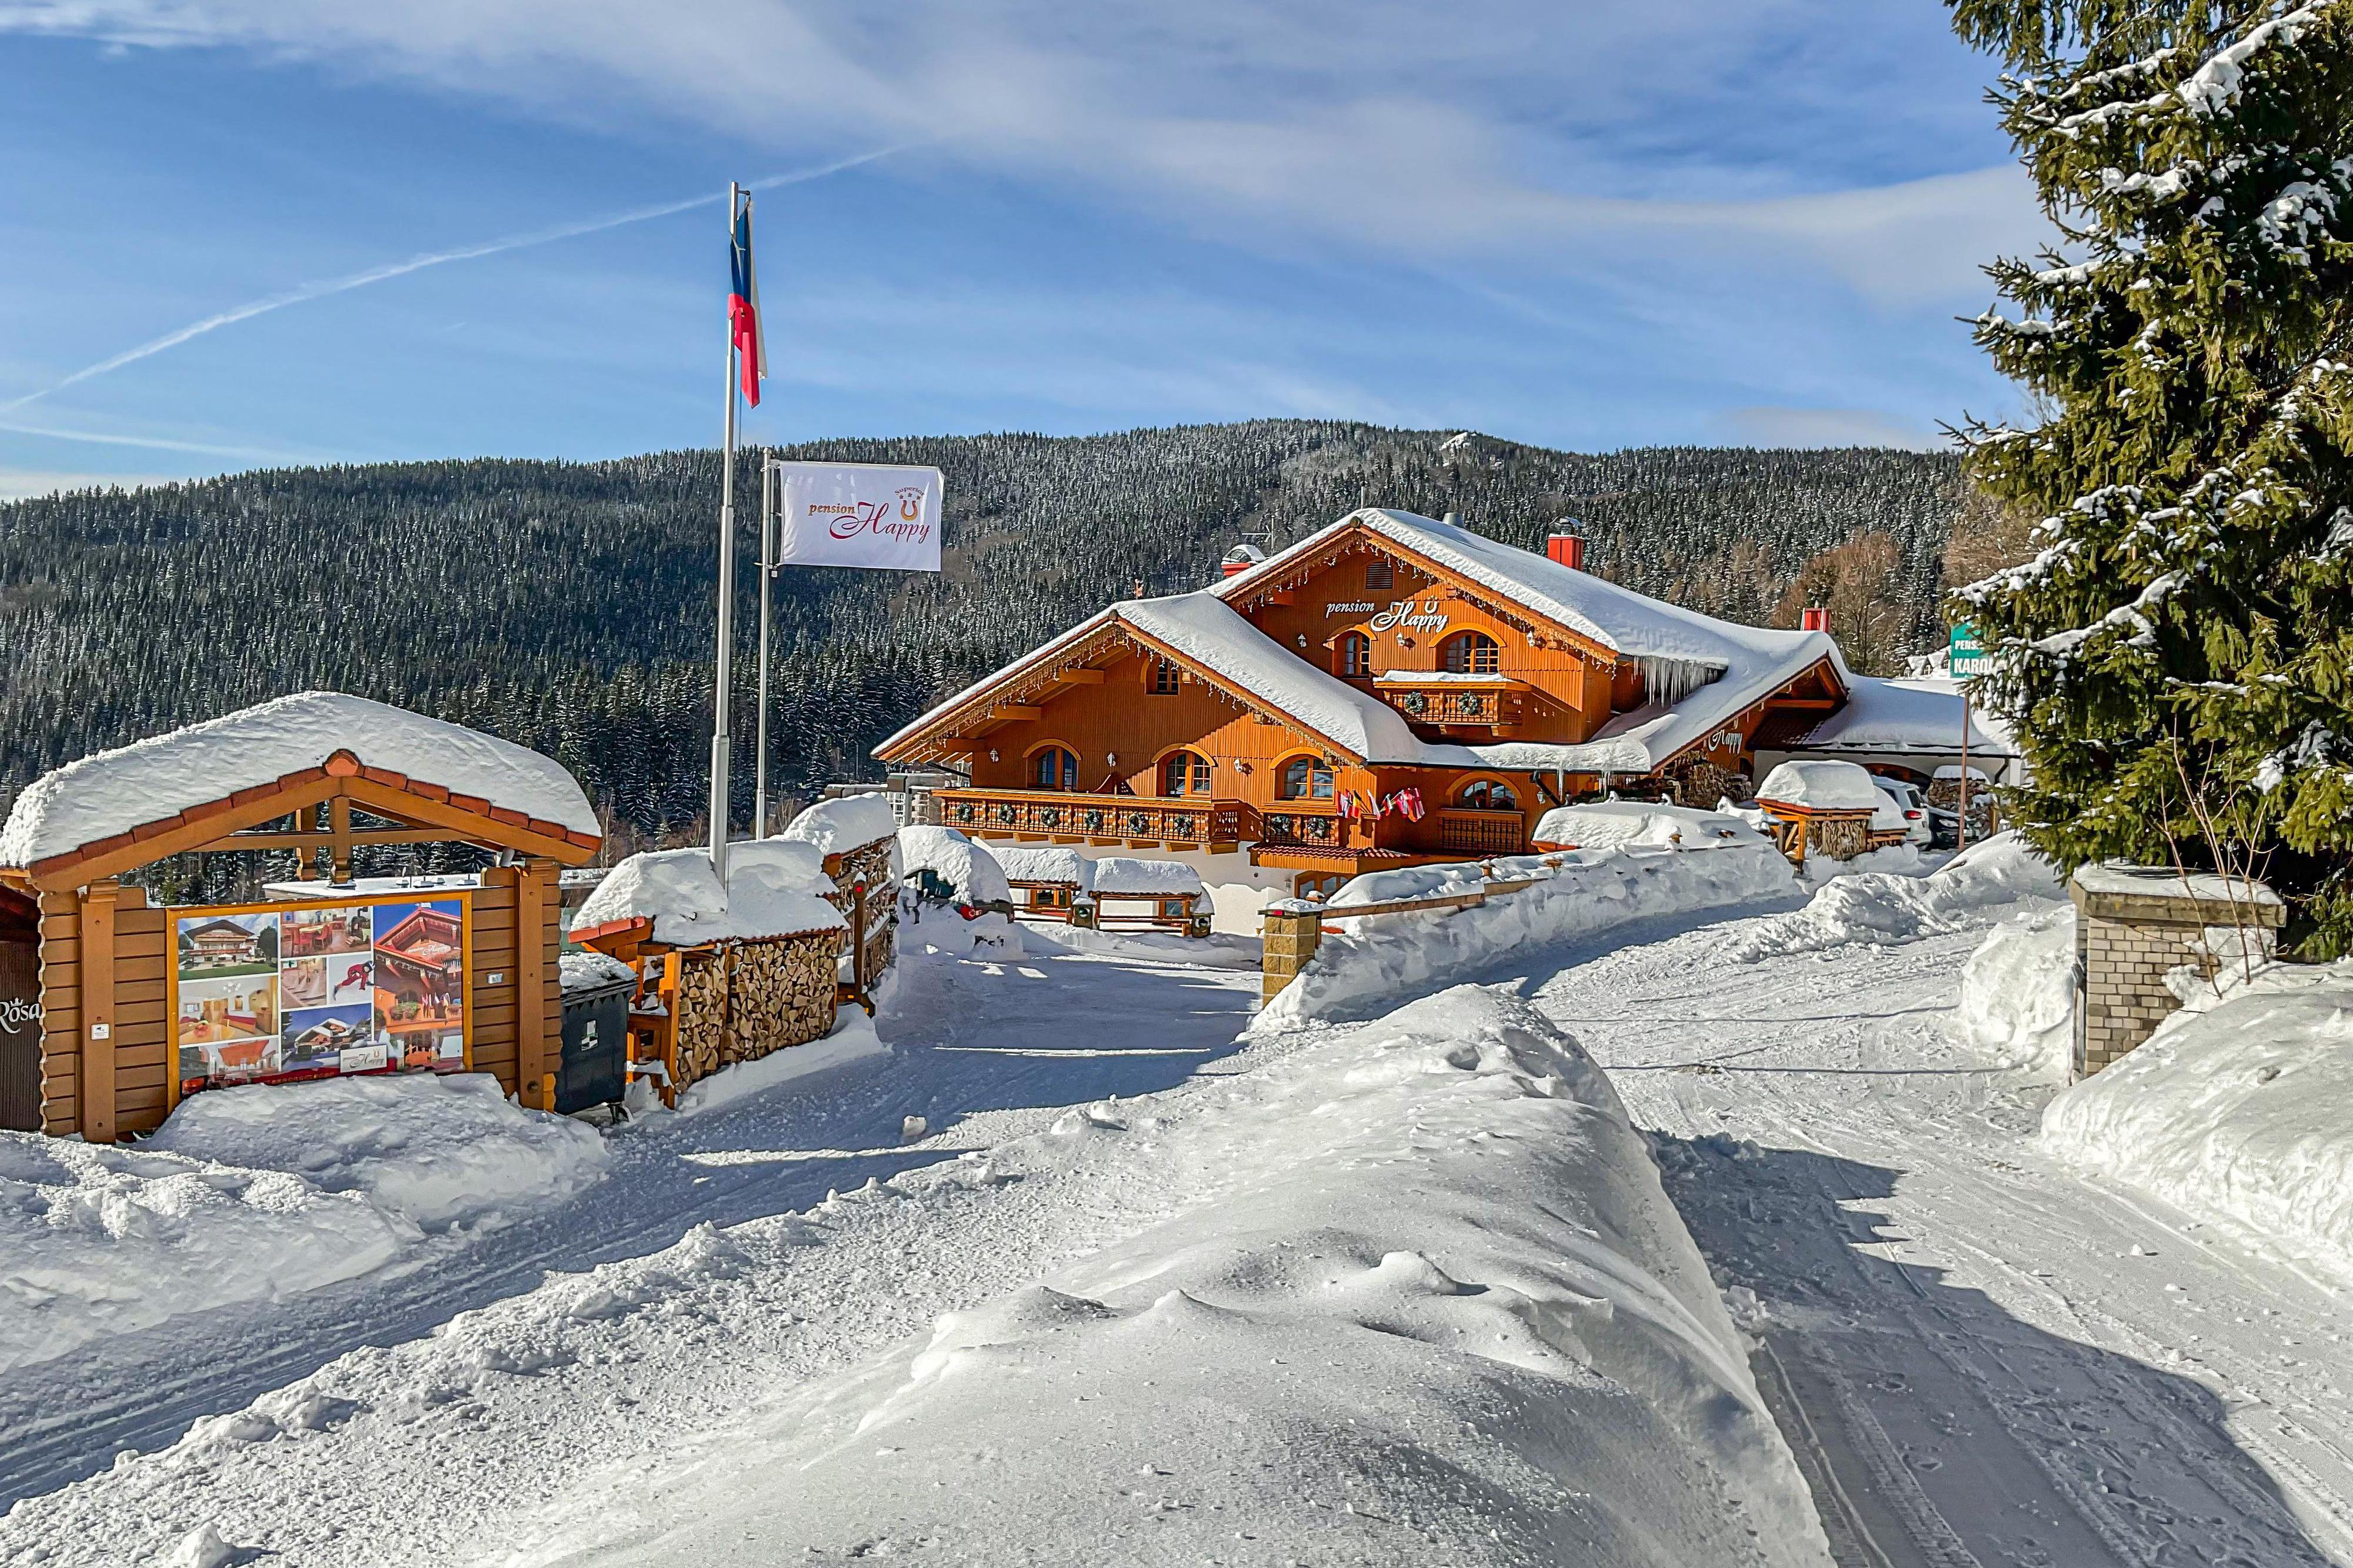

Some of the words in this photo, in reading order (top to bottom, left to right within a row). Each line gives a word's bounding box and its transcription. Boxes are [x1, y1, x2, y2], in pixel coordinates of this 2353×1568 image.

[808, 503, 855, 516] pension
[829, 502, 931, 544] Happy
[1326, 599, 1375, 619] pension
[1371, 601, 1449, 633] Happy
